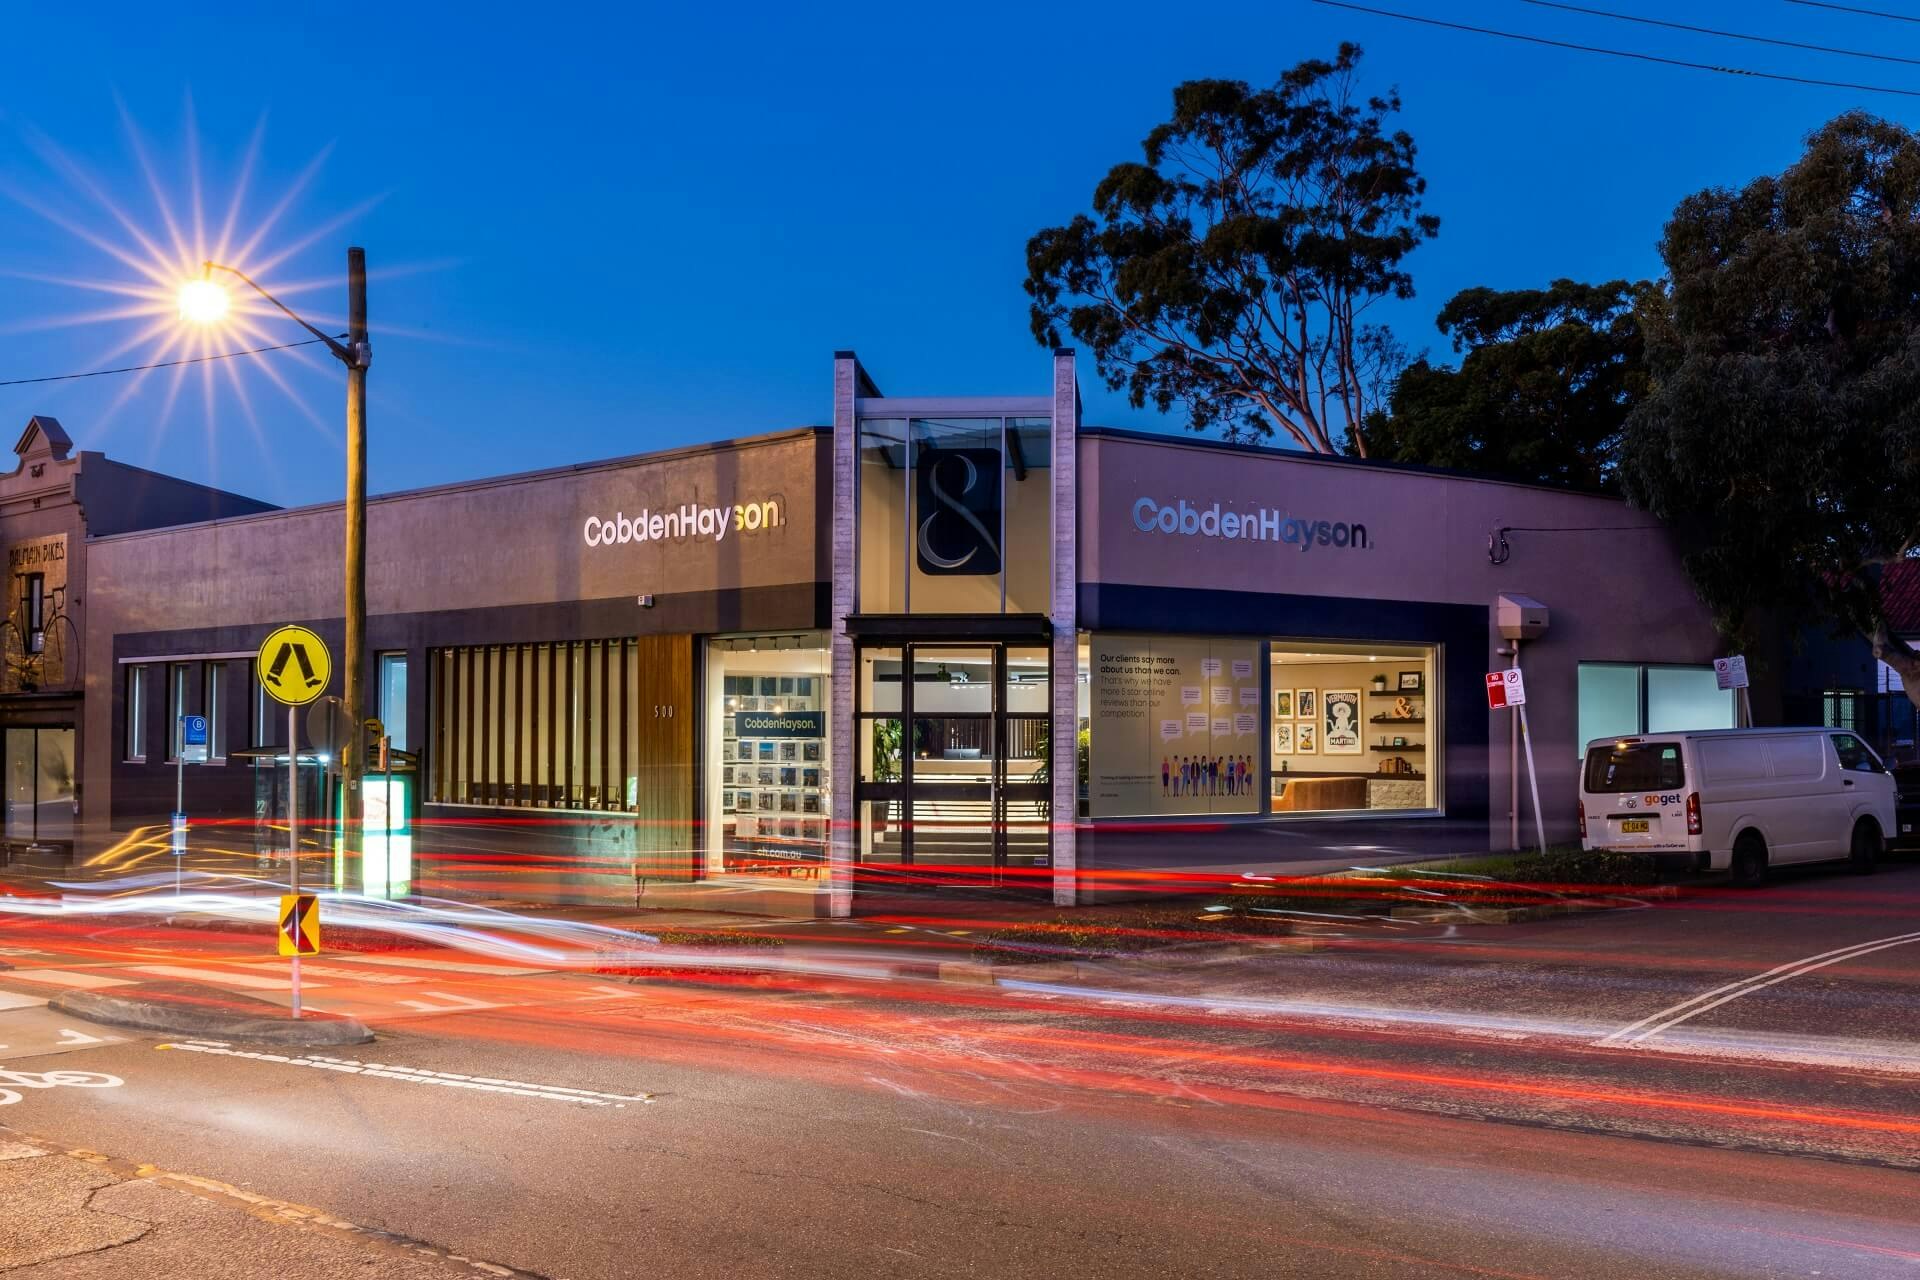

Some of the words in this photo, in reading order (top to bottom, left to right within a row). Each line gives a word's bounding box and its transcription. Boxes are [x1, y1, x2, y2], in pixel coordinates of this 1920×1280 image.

[43, 541, 65, 562] BIKES
[1101, 654, 1114, 663] Our
[1115, 654, 1140, 663] clients
[1141, 657, 1155, 666] say
[1156, 657, 1175, 665] more
[1101, 666, 1123, 674] about
[1135, 666, 1151, 675] than
[1165, 668, 1182, 676] can.
[1100, 676, 1122, 685] That's
[1153, 677, 1172, 686] have
[1101, 688, 1120, 696] more
[1127, 688, 1141, 696] star
[1142, 688, 1165, 697] online
[1130, 699, 1149, 707] than
[744, 717, 817, 732] CobdenHayson.
[1644, 793, 1682, 807] goget
